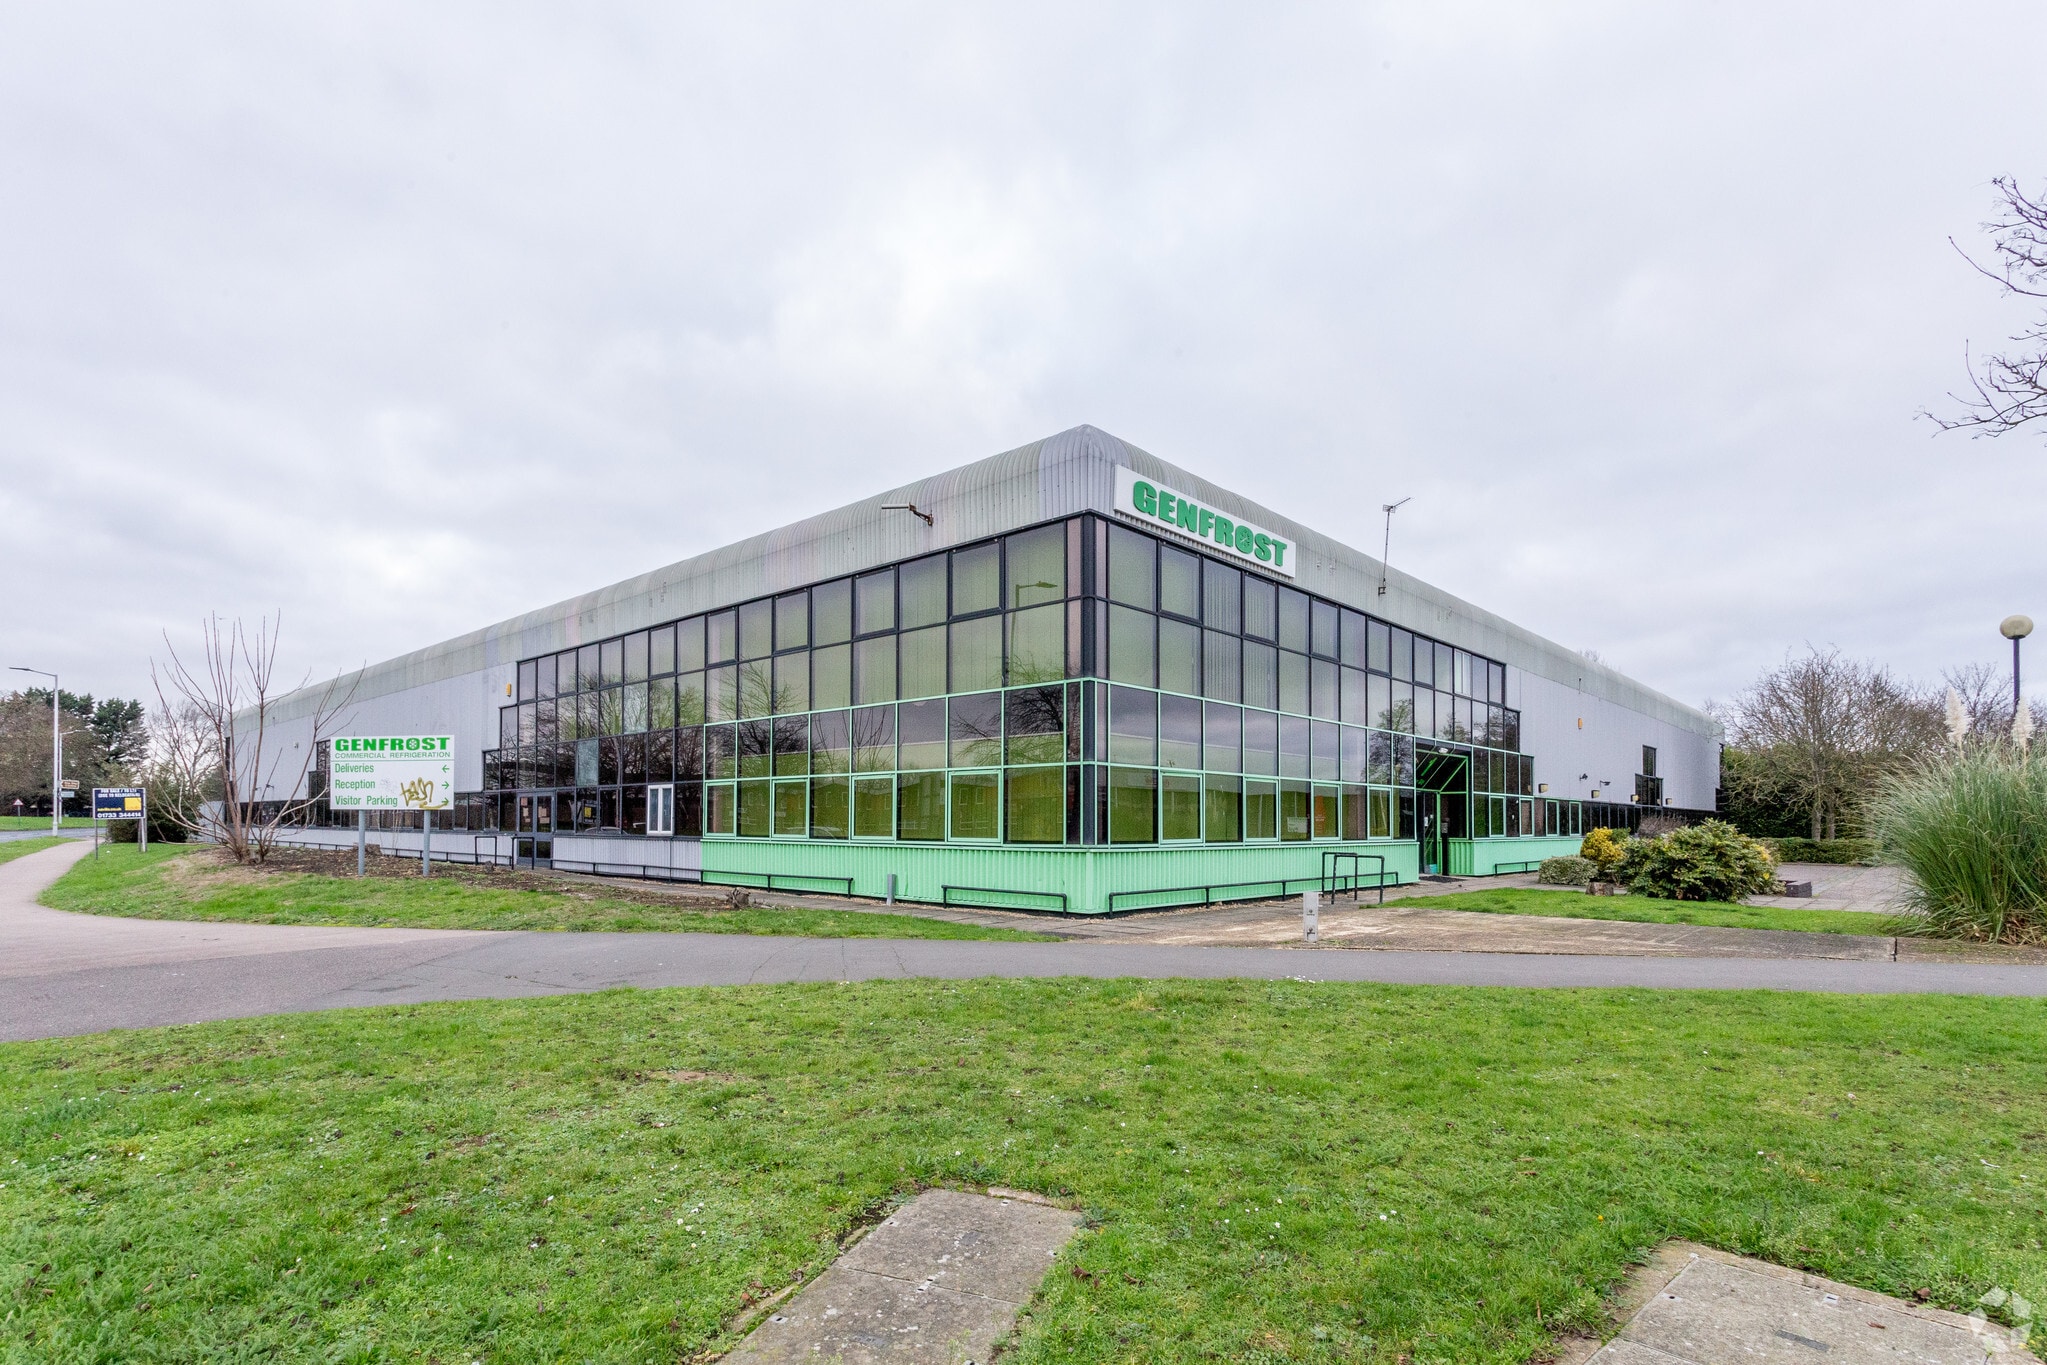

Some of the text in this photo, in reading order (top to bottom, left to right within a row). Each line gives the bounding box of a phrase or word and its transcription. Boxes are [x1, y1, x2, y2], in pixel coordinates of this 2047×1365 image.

[1133, 481, 1287, 567] GENFROST
[335, 738, 450, 751] GENFROST
[389, 751, 451, 759] REFRIGERATION
[335, 763, 374, 773] Deliveries
[335, 779, 376, 791] Reception
[335, 795, 398, 807] Visitor Parking
